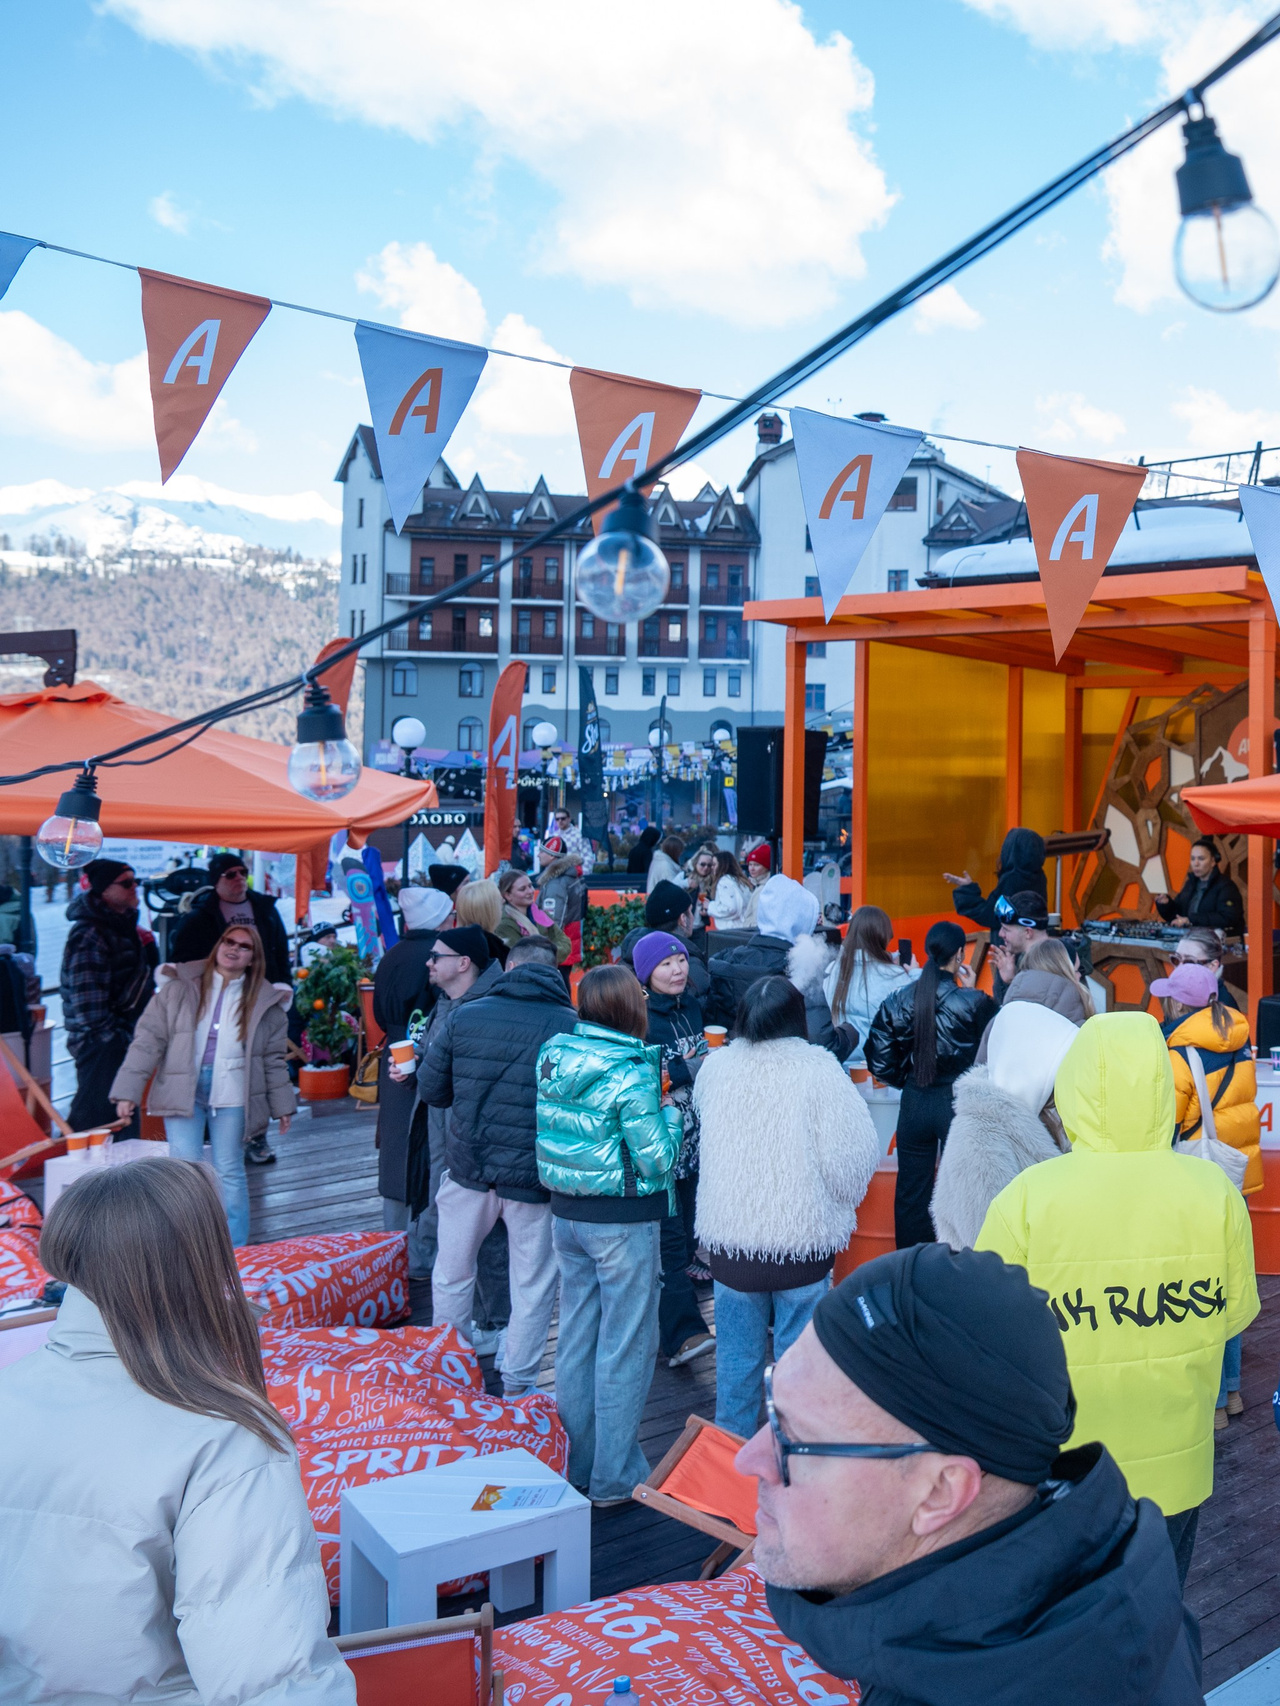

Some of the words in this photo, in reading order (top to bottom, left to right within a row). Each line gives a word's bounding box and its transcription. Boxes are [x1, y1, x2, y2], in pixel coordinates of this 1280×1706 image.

[164, 319, 221, 385] A
[389, 367, 443, 436] A
[598, 412, 656, 479] A
[819, 454, 872, 520] A
[1049, 494, 1098, 561] A
[444, 1398, 552, 1436] 1919
[460, 1423, 553, 1457] Aperitif
[551, 1618, 620, 1660] CONTAGIOUS
